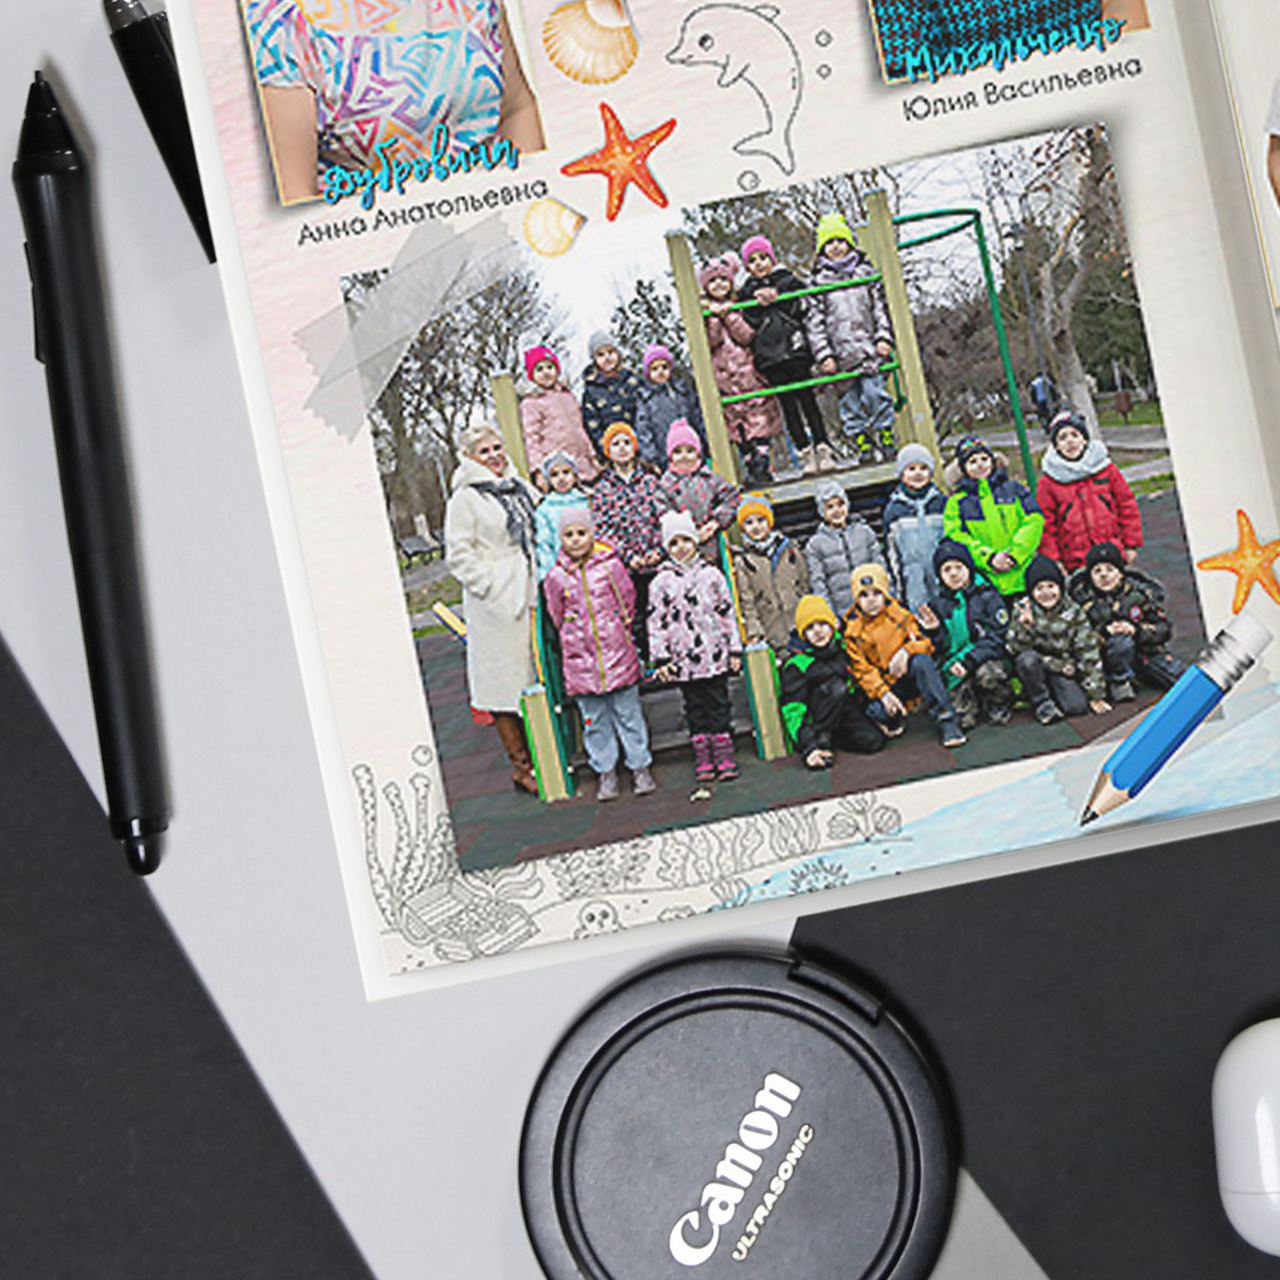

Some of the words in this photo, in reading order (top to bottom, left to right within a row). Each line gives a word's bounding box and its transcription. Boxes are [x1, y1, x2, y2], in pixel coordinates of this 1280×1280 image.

[902, 92, 979, 122] Юлия
[983, 58, 1143, 106] Васильевна
[322, 122, 521, 211] Дубровина
[298, 217, 367, 246] Анна
[373, 179, 549, 232] Анатольевна
[669, 1073, 801, 1266] Canon
[732, 1124, 815, 1261] ULTRASONIC
